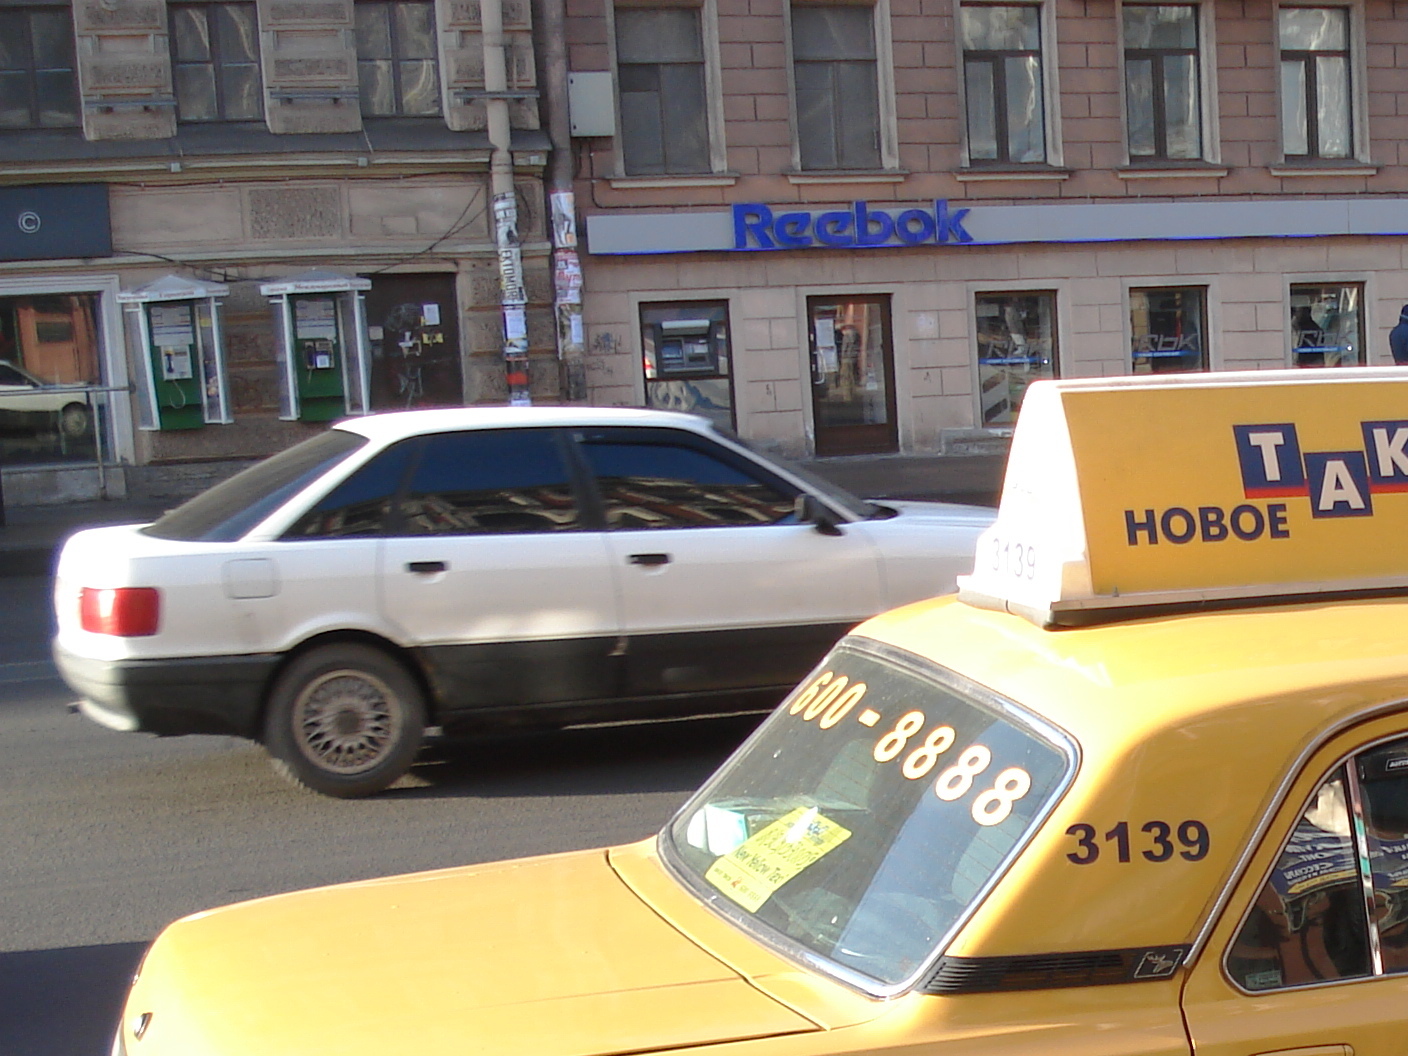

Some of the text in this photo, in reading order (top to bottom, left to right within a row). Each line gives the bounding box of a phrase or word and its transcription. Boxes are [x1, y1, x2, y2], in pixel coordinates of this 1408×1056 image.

[732, 199, 974, 249] Reebok
[1124, 503, 1290, 546] НОВОЕ
[1066, 820, 1210, 865] 3139
